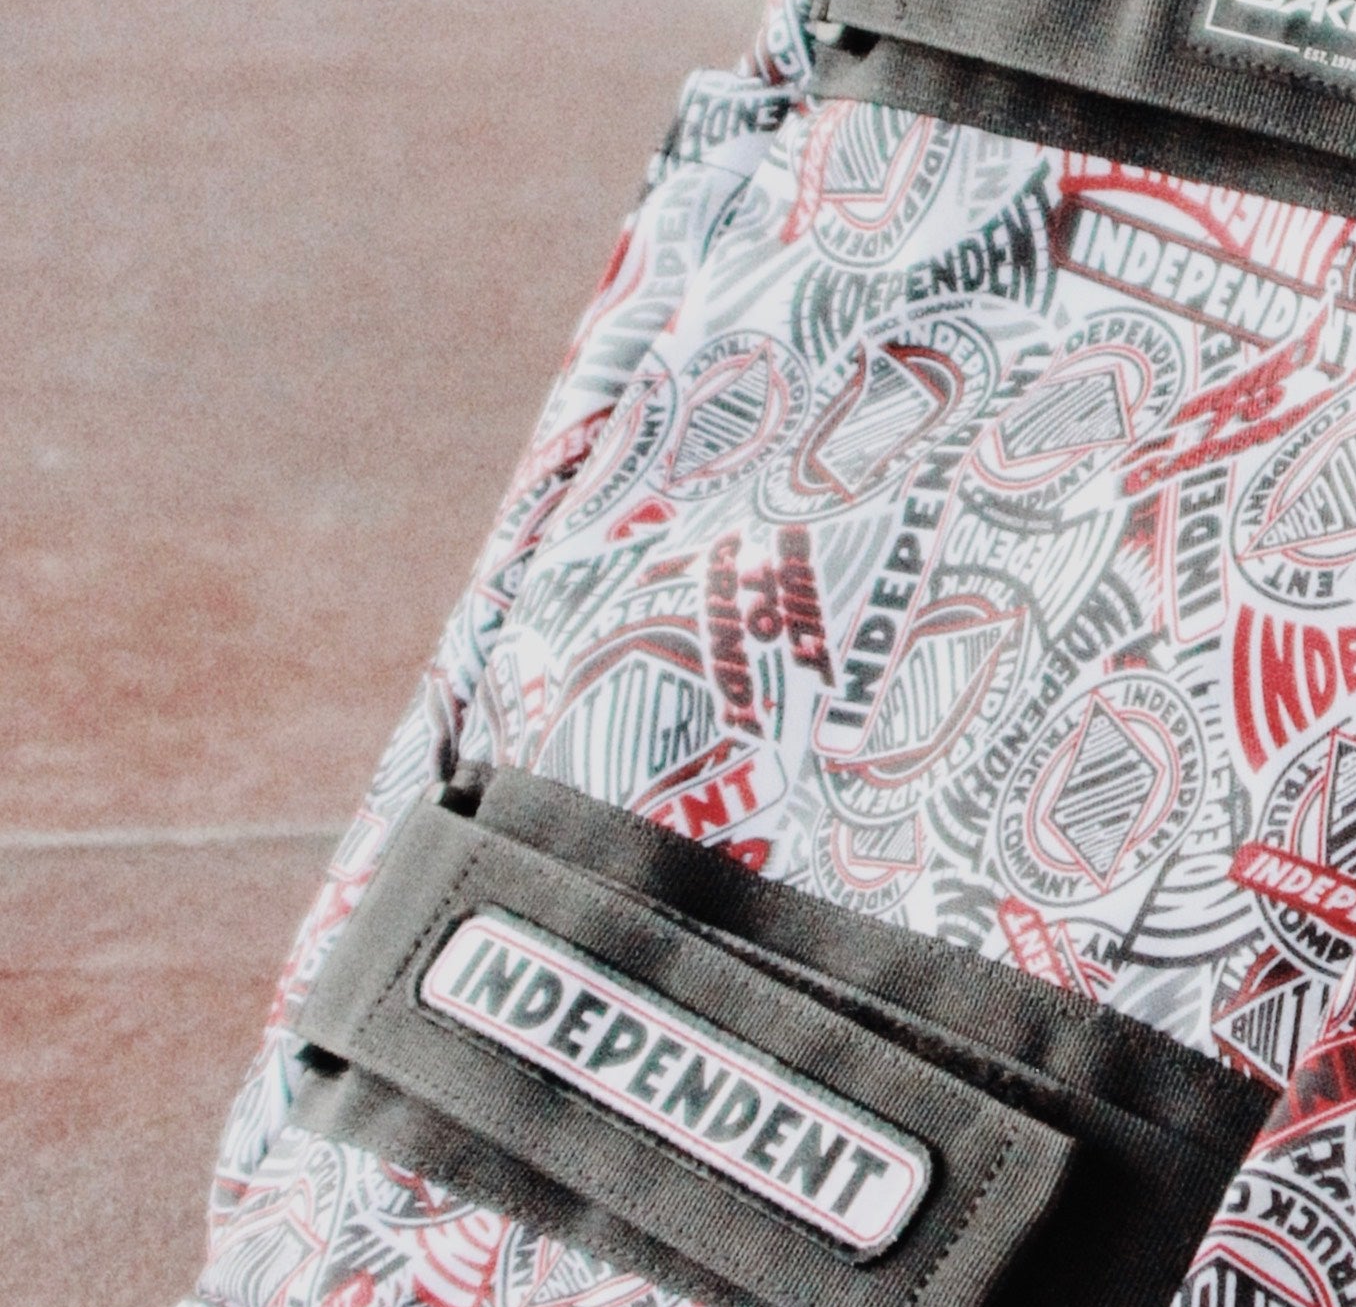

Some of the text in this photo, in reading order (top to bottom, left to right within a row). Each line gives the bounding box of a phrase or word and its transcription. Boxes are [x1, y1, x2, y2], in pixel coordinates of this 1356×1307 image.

[1303, 46, 1328, 66] EST.
[790, 158, 1056, 367] INDEPENDENT
[907, 298, 974, 320] COMPANY
[1122, 681, 1201, 871] INDEPENDENT
[1002, 811, 1082, 899] COMPANY
[450, 938, 890, 1219] INDEPENDENT
